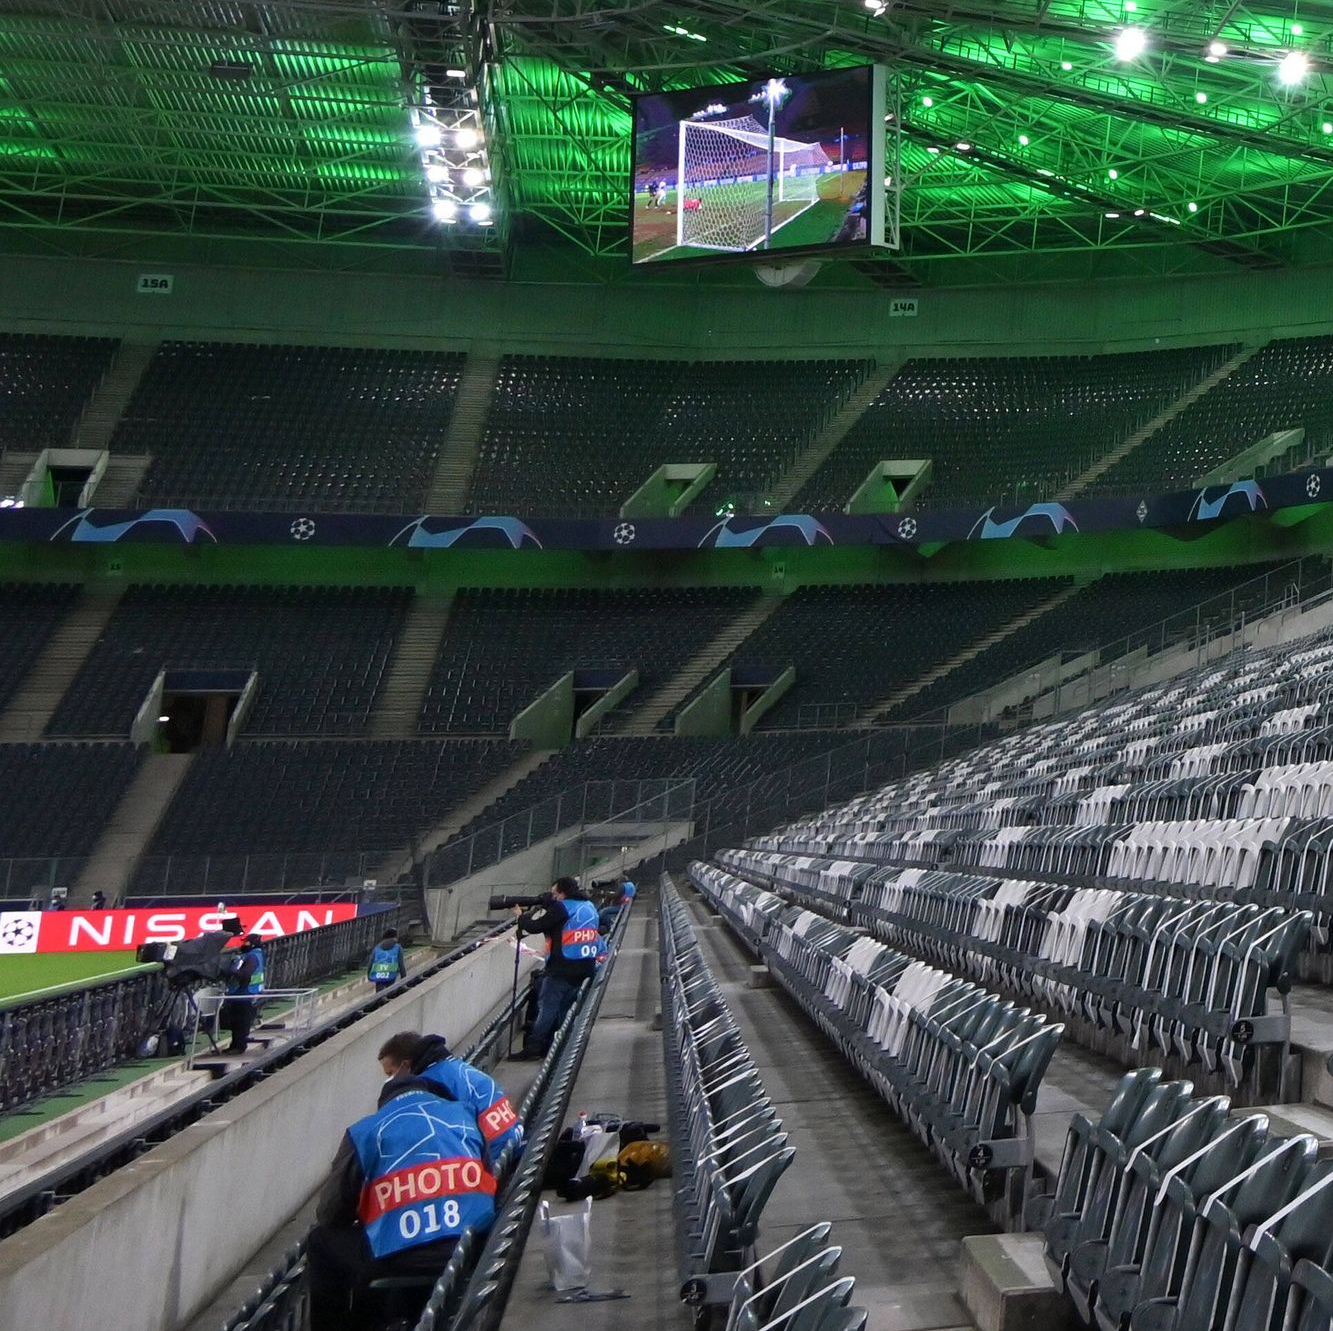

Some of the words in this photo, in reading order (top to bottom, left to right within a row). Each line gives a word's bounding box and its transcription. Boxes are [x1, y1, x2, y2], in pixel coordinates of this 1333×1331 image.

[141, 278, 169, 288] 15A
[893, 302, 915, 312] 14A
[375, 1161, 482, 1211] PHOTO
[399, 1199, 461, 1239] 018
